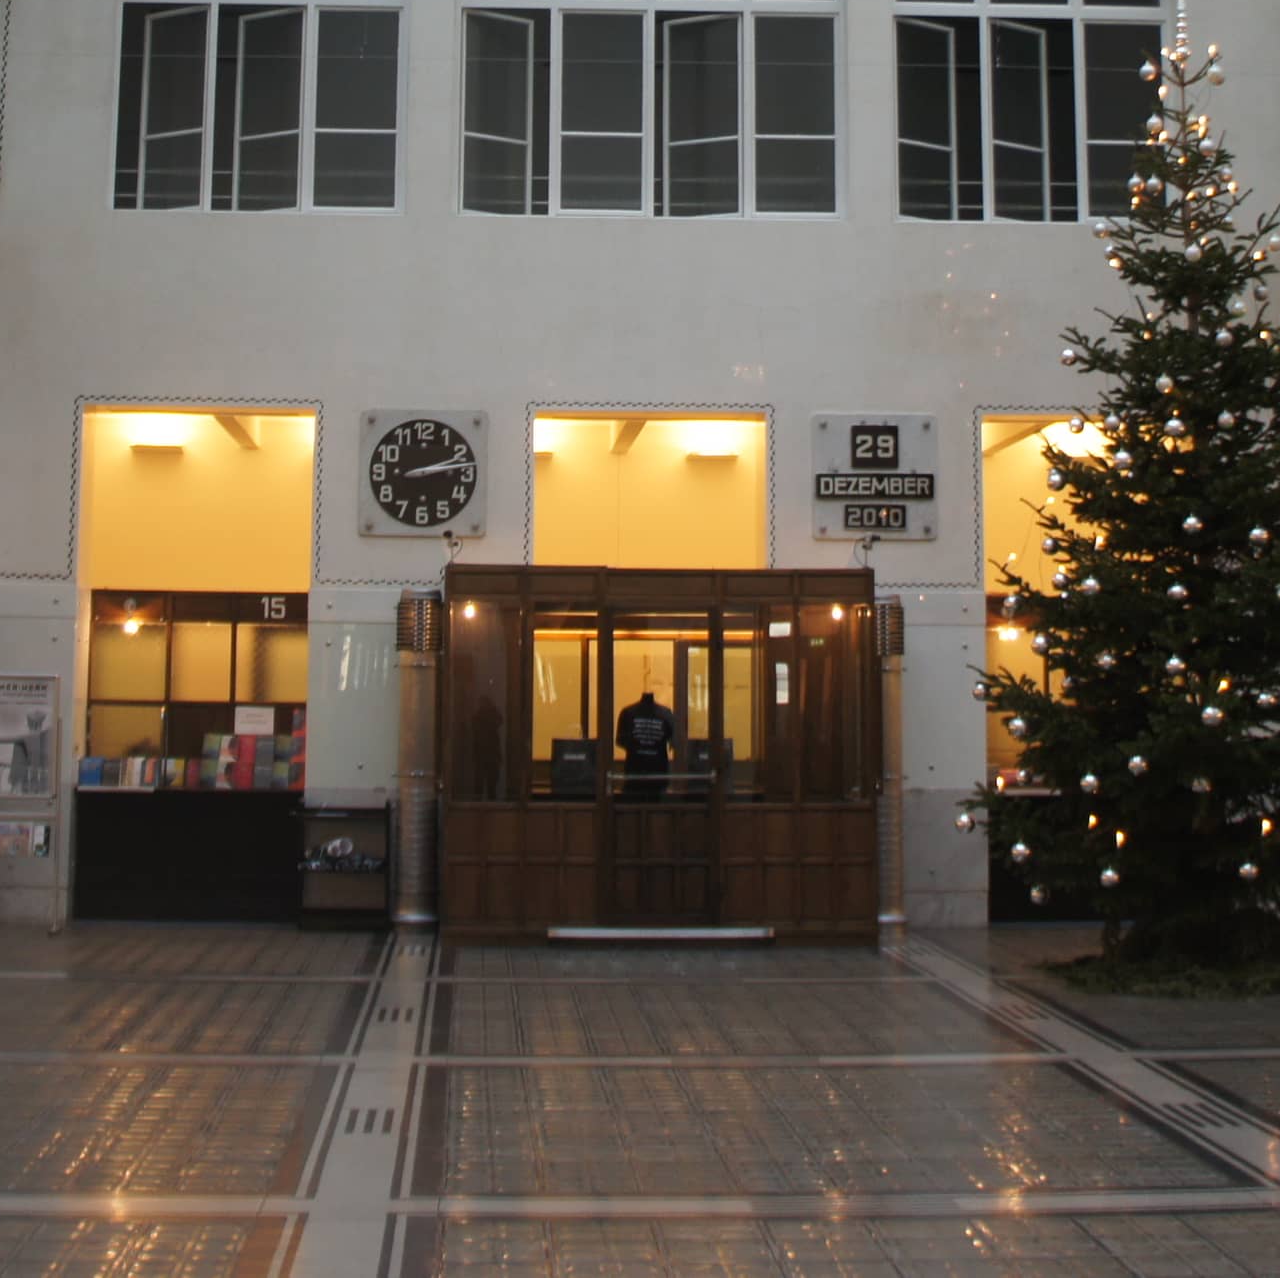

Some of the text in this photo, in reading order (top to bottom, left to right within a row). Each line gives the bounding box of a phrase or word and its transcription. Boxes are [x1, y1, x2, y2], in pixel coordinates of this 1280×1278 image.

[394, 428, 411, 446] 11
[414, 422, 435, 440] 12
[441, 428, 450, 446] 1
[378, 444, 400, 462] 10
[454, 444, 467, 462] 2
[855, 434, 895, 458] 29
[372, 463, 386, 481] 9
[460, 465, 474, 482] 3
[380, 484, 393, 502] 8
[451, 485, 467, 503] 4
[820, 477, 930, 495] DEZEMBER
[395, 500, 409, 518] 7
[415, 506, 428, 524] 6
[436, 500, 450, 518] 5
[847, 507, 904, 527] 2010
[260, 596, 287, 619] 15
